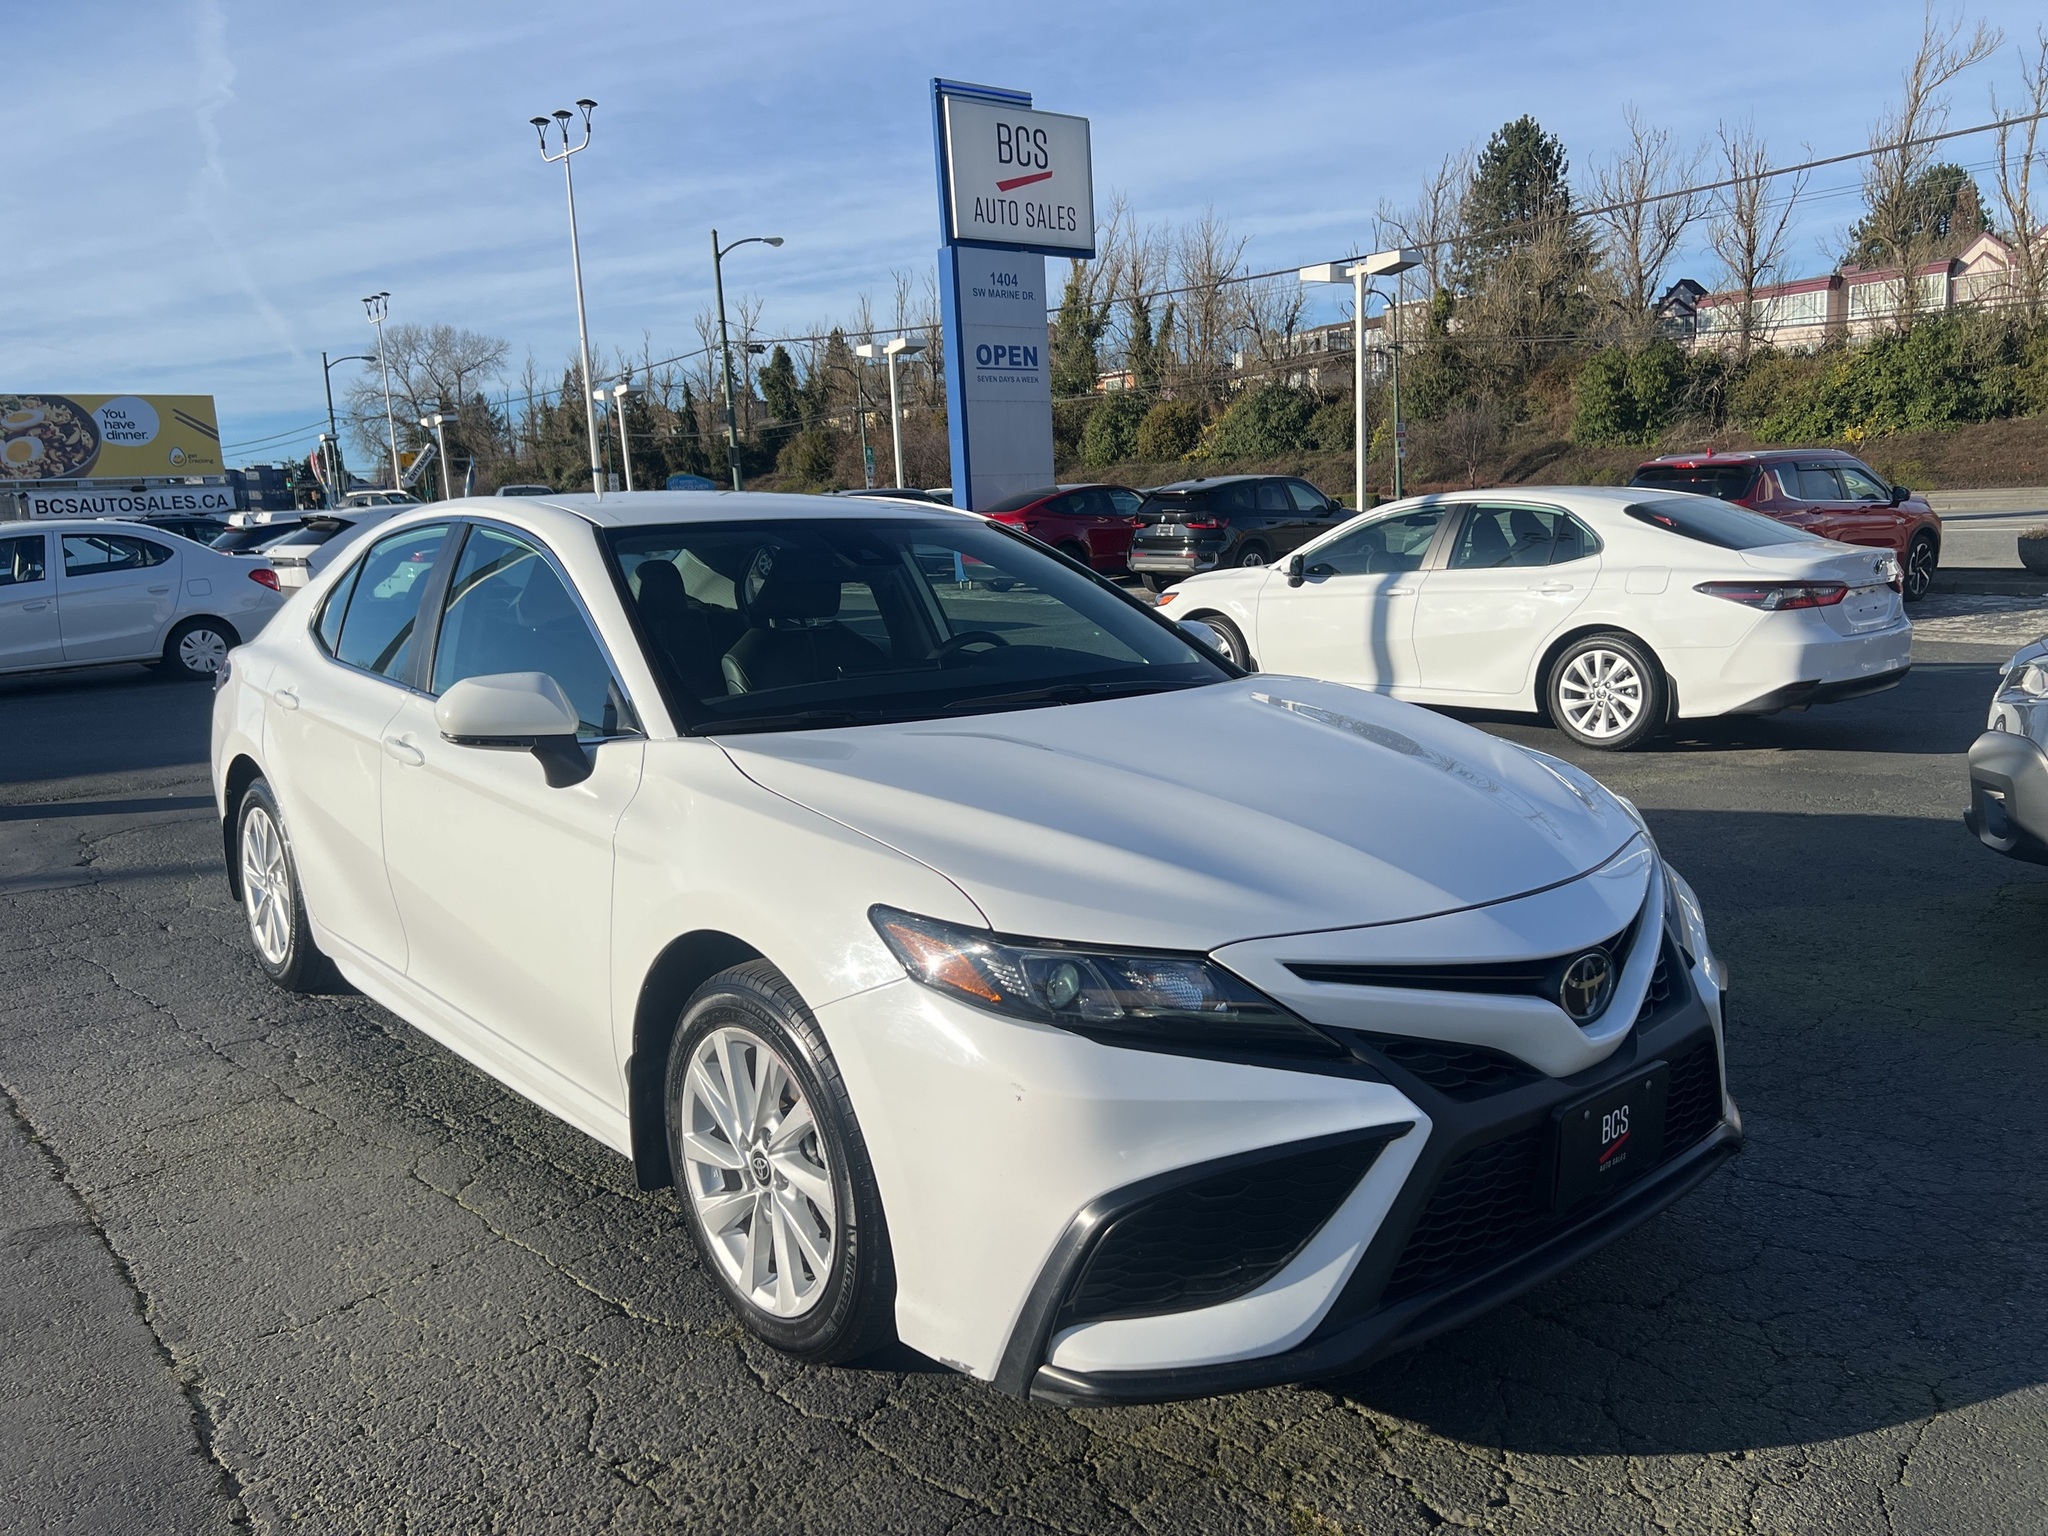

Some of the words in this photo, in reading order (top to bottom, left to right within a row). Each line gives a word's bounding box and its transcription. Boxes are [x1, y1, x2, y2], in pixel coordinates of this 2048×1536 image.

[997, 122, 1048, 169] BCS
[974, 197, 1019, 226] AUTO
[1025, 202, 1076, 231] SALES
[990, 272, 1018, 287] 1404
[972, 287, 986, 298] SW
[988, 288, 1020, 300] MARINE
[1022, 291, 1037, 301] DR.
[976, 344, 1038, 367] OPEN
[977, 375, 999, 383] SEVEN
[999, 375, 1015, 383] DAYS
[1021, 376, 1039, 384] WEEK
[101, 408, 126, 419] You
[104, 419, 136, 430] have
[106, 430, 149, 440] dinner.
[408, 449, 435, 482] ENTRANCE
[35, 494, 229, 515] BCSAUTOSALES.CA
[1602, 1105, 1629, 1145] BCS
